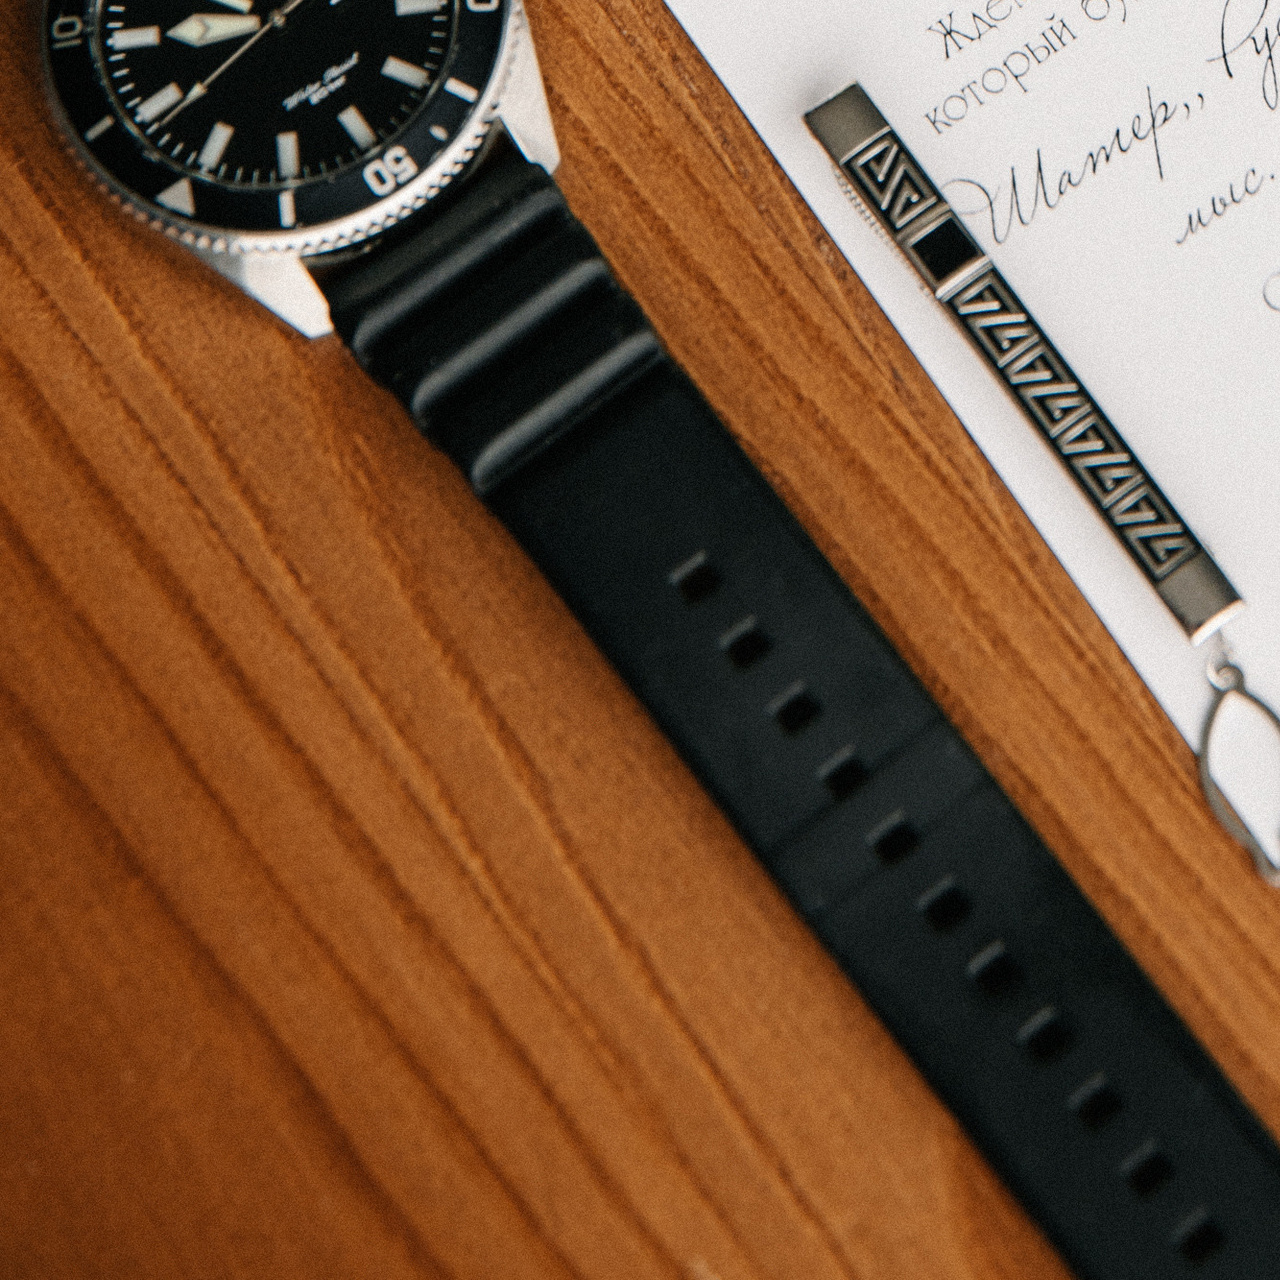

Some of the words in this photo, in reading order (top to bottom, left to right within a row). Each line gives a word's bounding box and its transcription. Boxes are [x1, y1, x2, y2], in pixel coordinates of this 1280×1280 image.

[51, 16, 84, 50] 10
[923, 12, 1079, 135] который
[361, 145, 419, 198] 50
